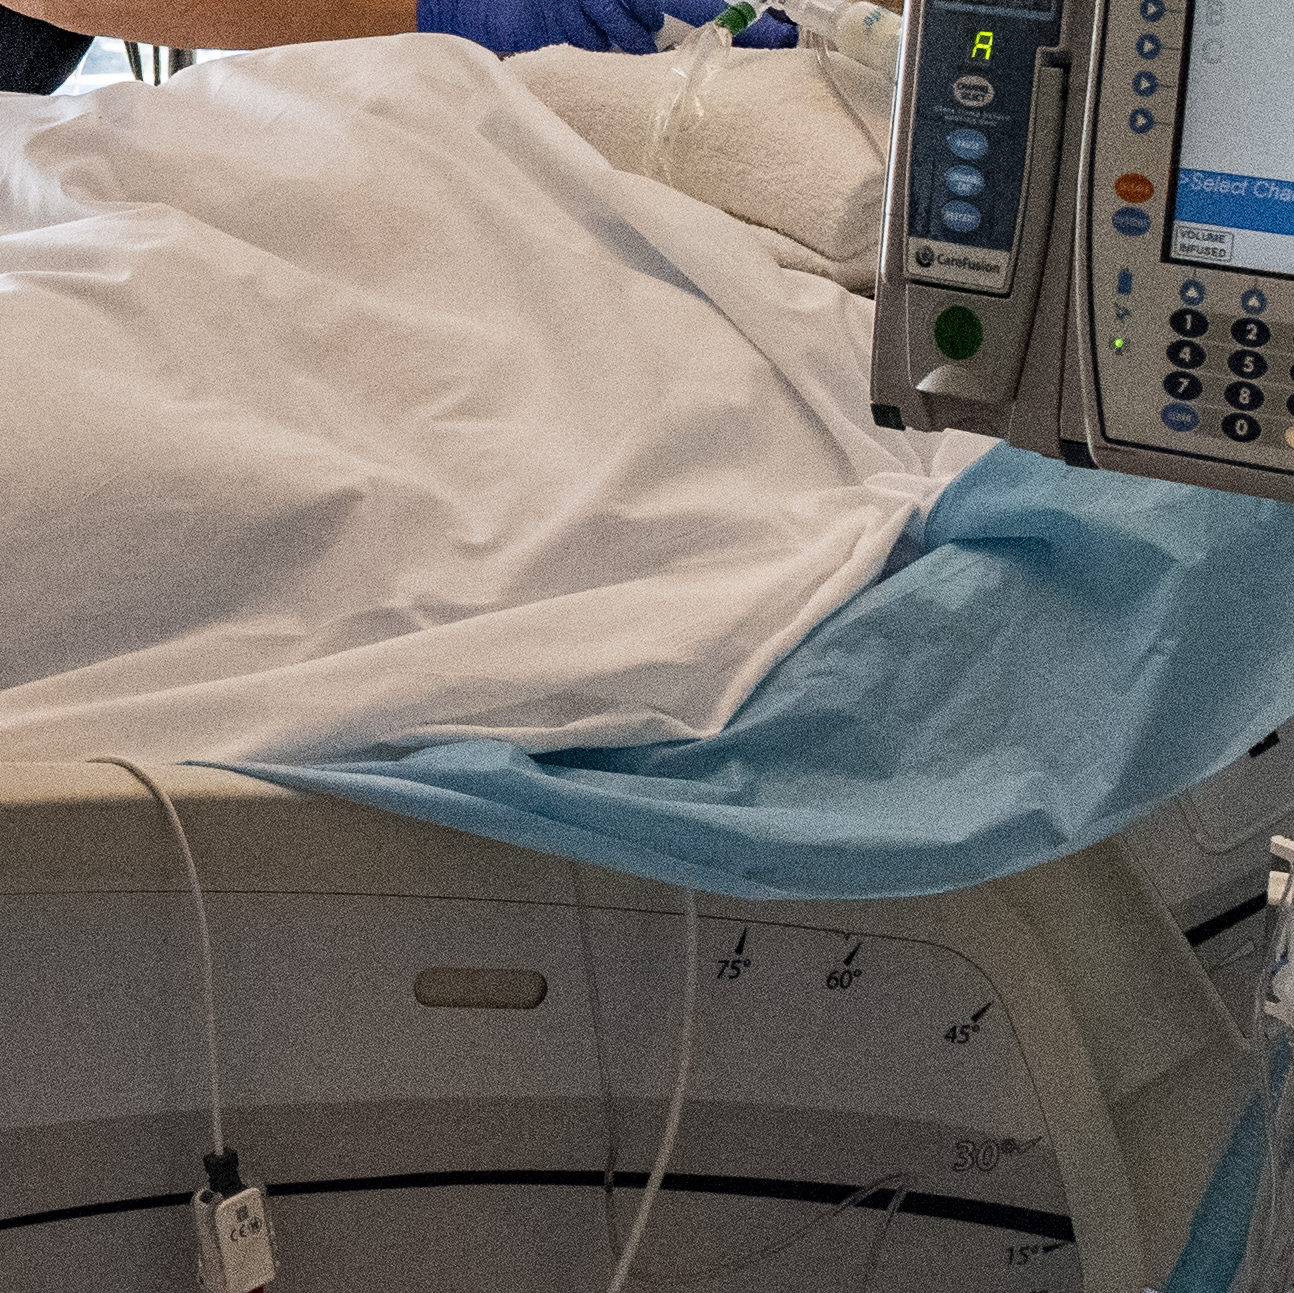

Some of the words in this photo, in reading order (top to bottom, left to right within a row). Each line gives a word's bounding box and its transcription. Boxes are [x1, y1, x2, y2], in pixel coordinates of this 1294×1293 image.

[971, 31, 994, 60] A
[1180, 229, 1226, 244] VOLUME
[1179, 242, 1227, 259] INFUSED
[936, 253, 1000, 273] CareFusion
[1184, 314, 1193, 329] 1
[1246, 324, 1258, 339] 2
[1179, 347, 1191, 362] 4
[1243, 356, 1254, 372] 5
[1178, 378, 1189, 393] 7
[1239, 388, 1250, 404] 8
[1235, 419, 1247, 435] 0
[716, 958, 751, 980] 75°
[826, 968, 862, 990] 60°
[945, 1024, 980, 1044] 45°
[1006, 1244, 1040, 1266] 15°
